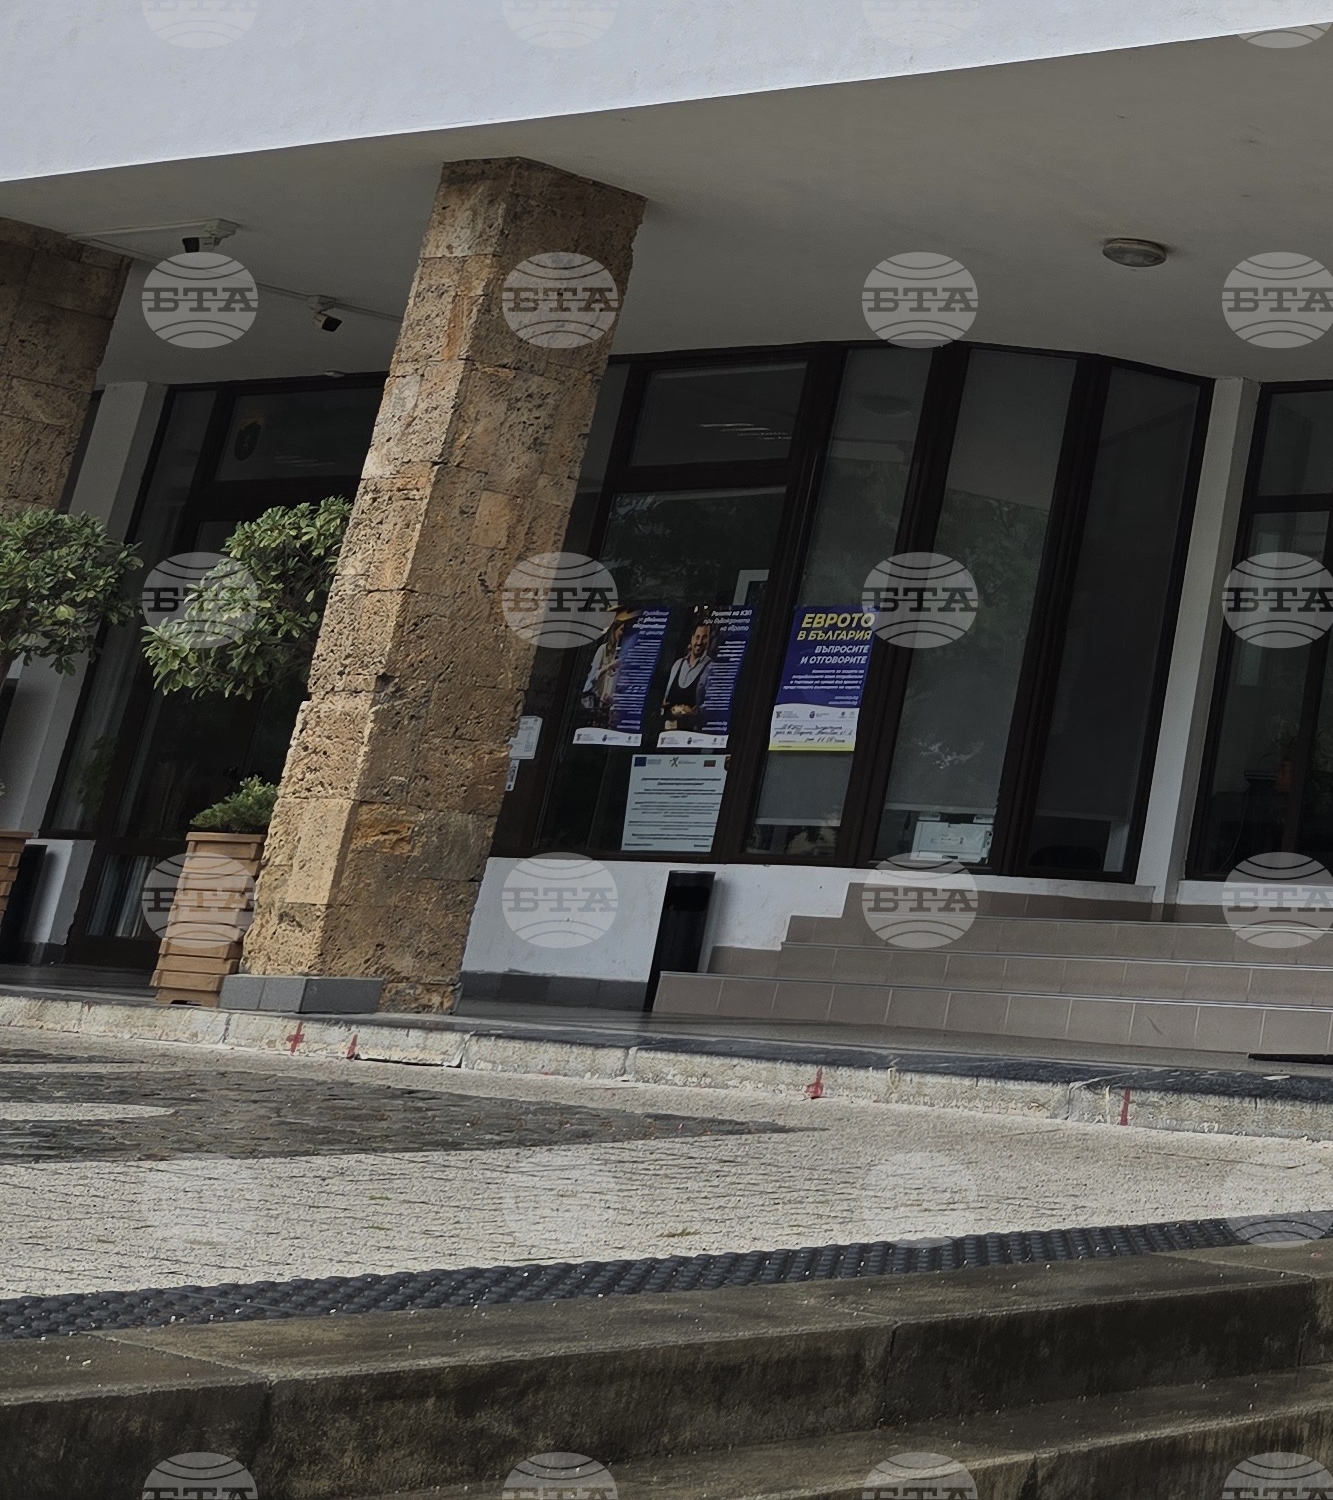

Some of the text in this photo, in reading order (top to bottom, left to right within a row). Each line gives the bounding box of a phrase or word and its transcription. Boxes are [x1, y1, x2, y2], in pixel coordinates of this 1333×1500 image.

[801, 613, 876, 628] ЕВРОТО
[797, 629, 873, 641] В БЪЛГАРИЯ
[814, 645, 870, 654] ВЪПРОСИТЕ
[800, 656, 868, 664] И ОТГОВОРИТЕ
